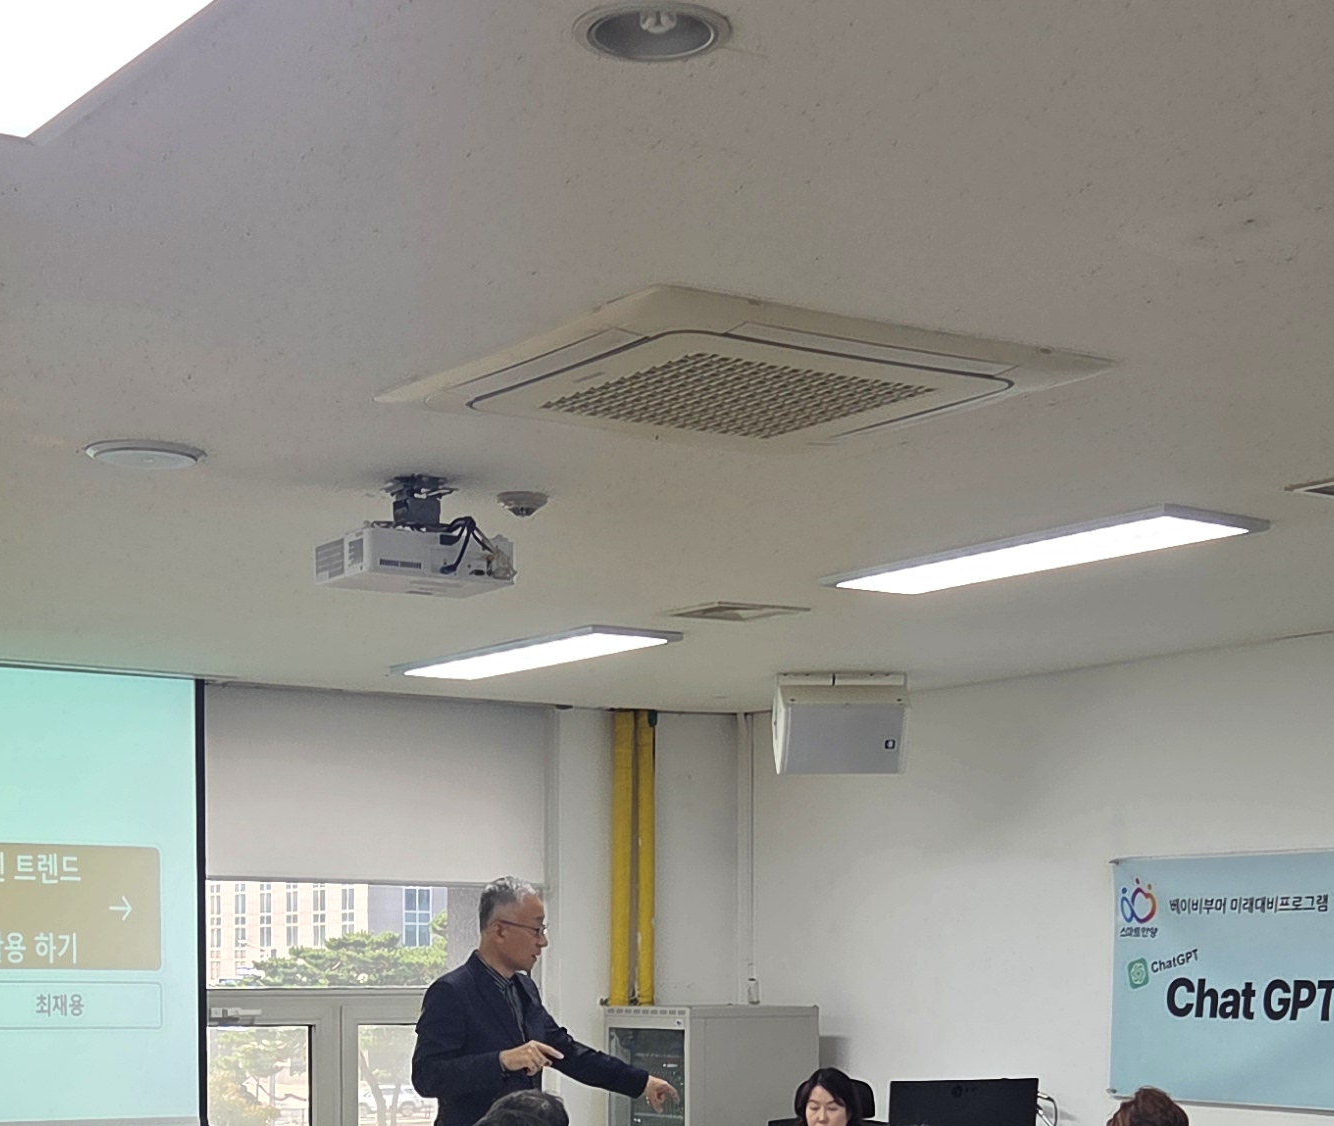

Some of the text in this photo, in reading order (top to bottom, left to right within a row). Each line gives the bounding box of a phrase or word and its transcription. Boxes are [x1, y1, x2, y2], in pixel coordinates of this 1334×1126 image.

[14, 852, 82, 884] 트렌드
[1169, 893, 1329, 915] 베이비부머 미래대비프로그램
[35, 932, 78, 963] 하기
[1151, 948, 1199, 973] ChatGPT
[35, 992, 85, 1018] 최재용
[1166, 977, 1255, 1020] Chat
